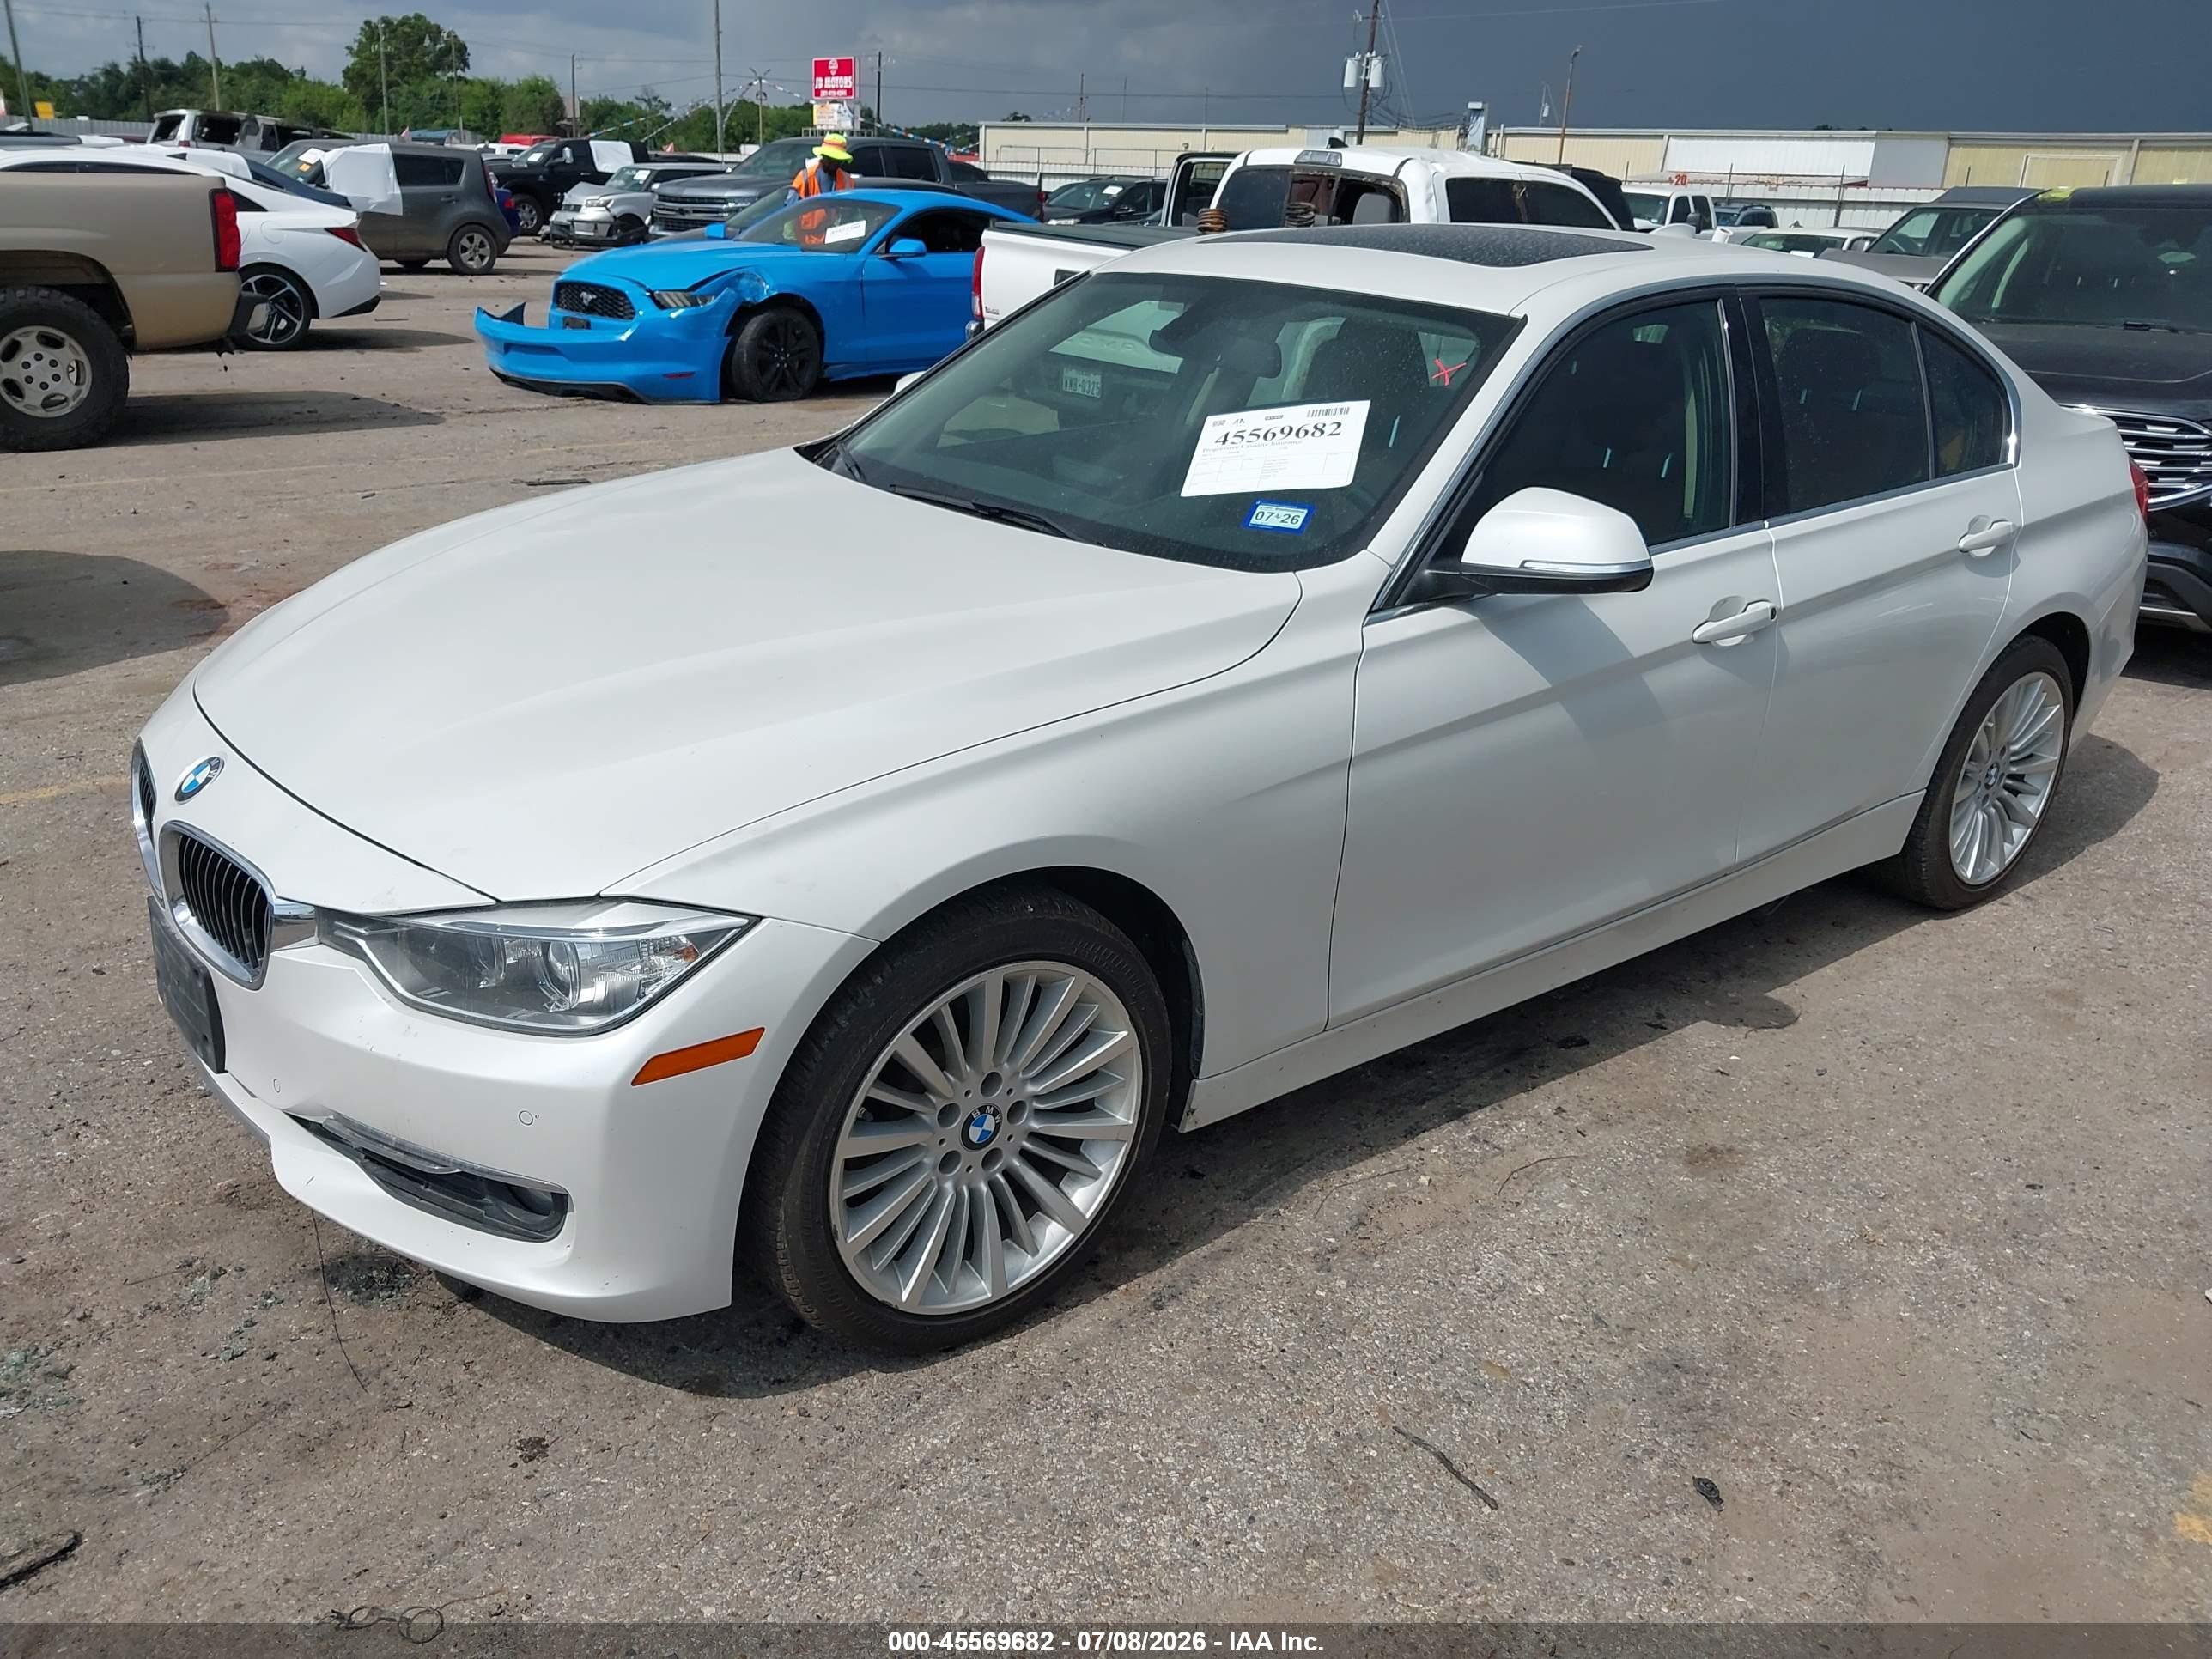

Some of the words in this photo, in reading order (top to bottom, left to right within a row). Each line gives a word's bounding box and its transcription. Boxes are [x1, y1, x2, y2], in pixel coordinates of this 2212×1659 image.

[824, 76, 853, 89] MOTORS
[1214, 422, 1343, 446] 45569682
[1255, 511, 1275, 521] 07
[1280, 514, 1301, 525] 26
[971, 1106, 1002, 1123] BMW
